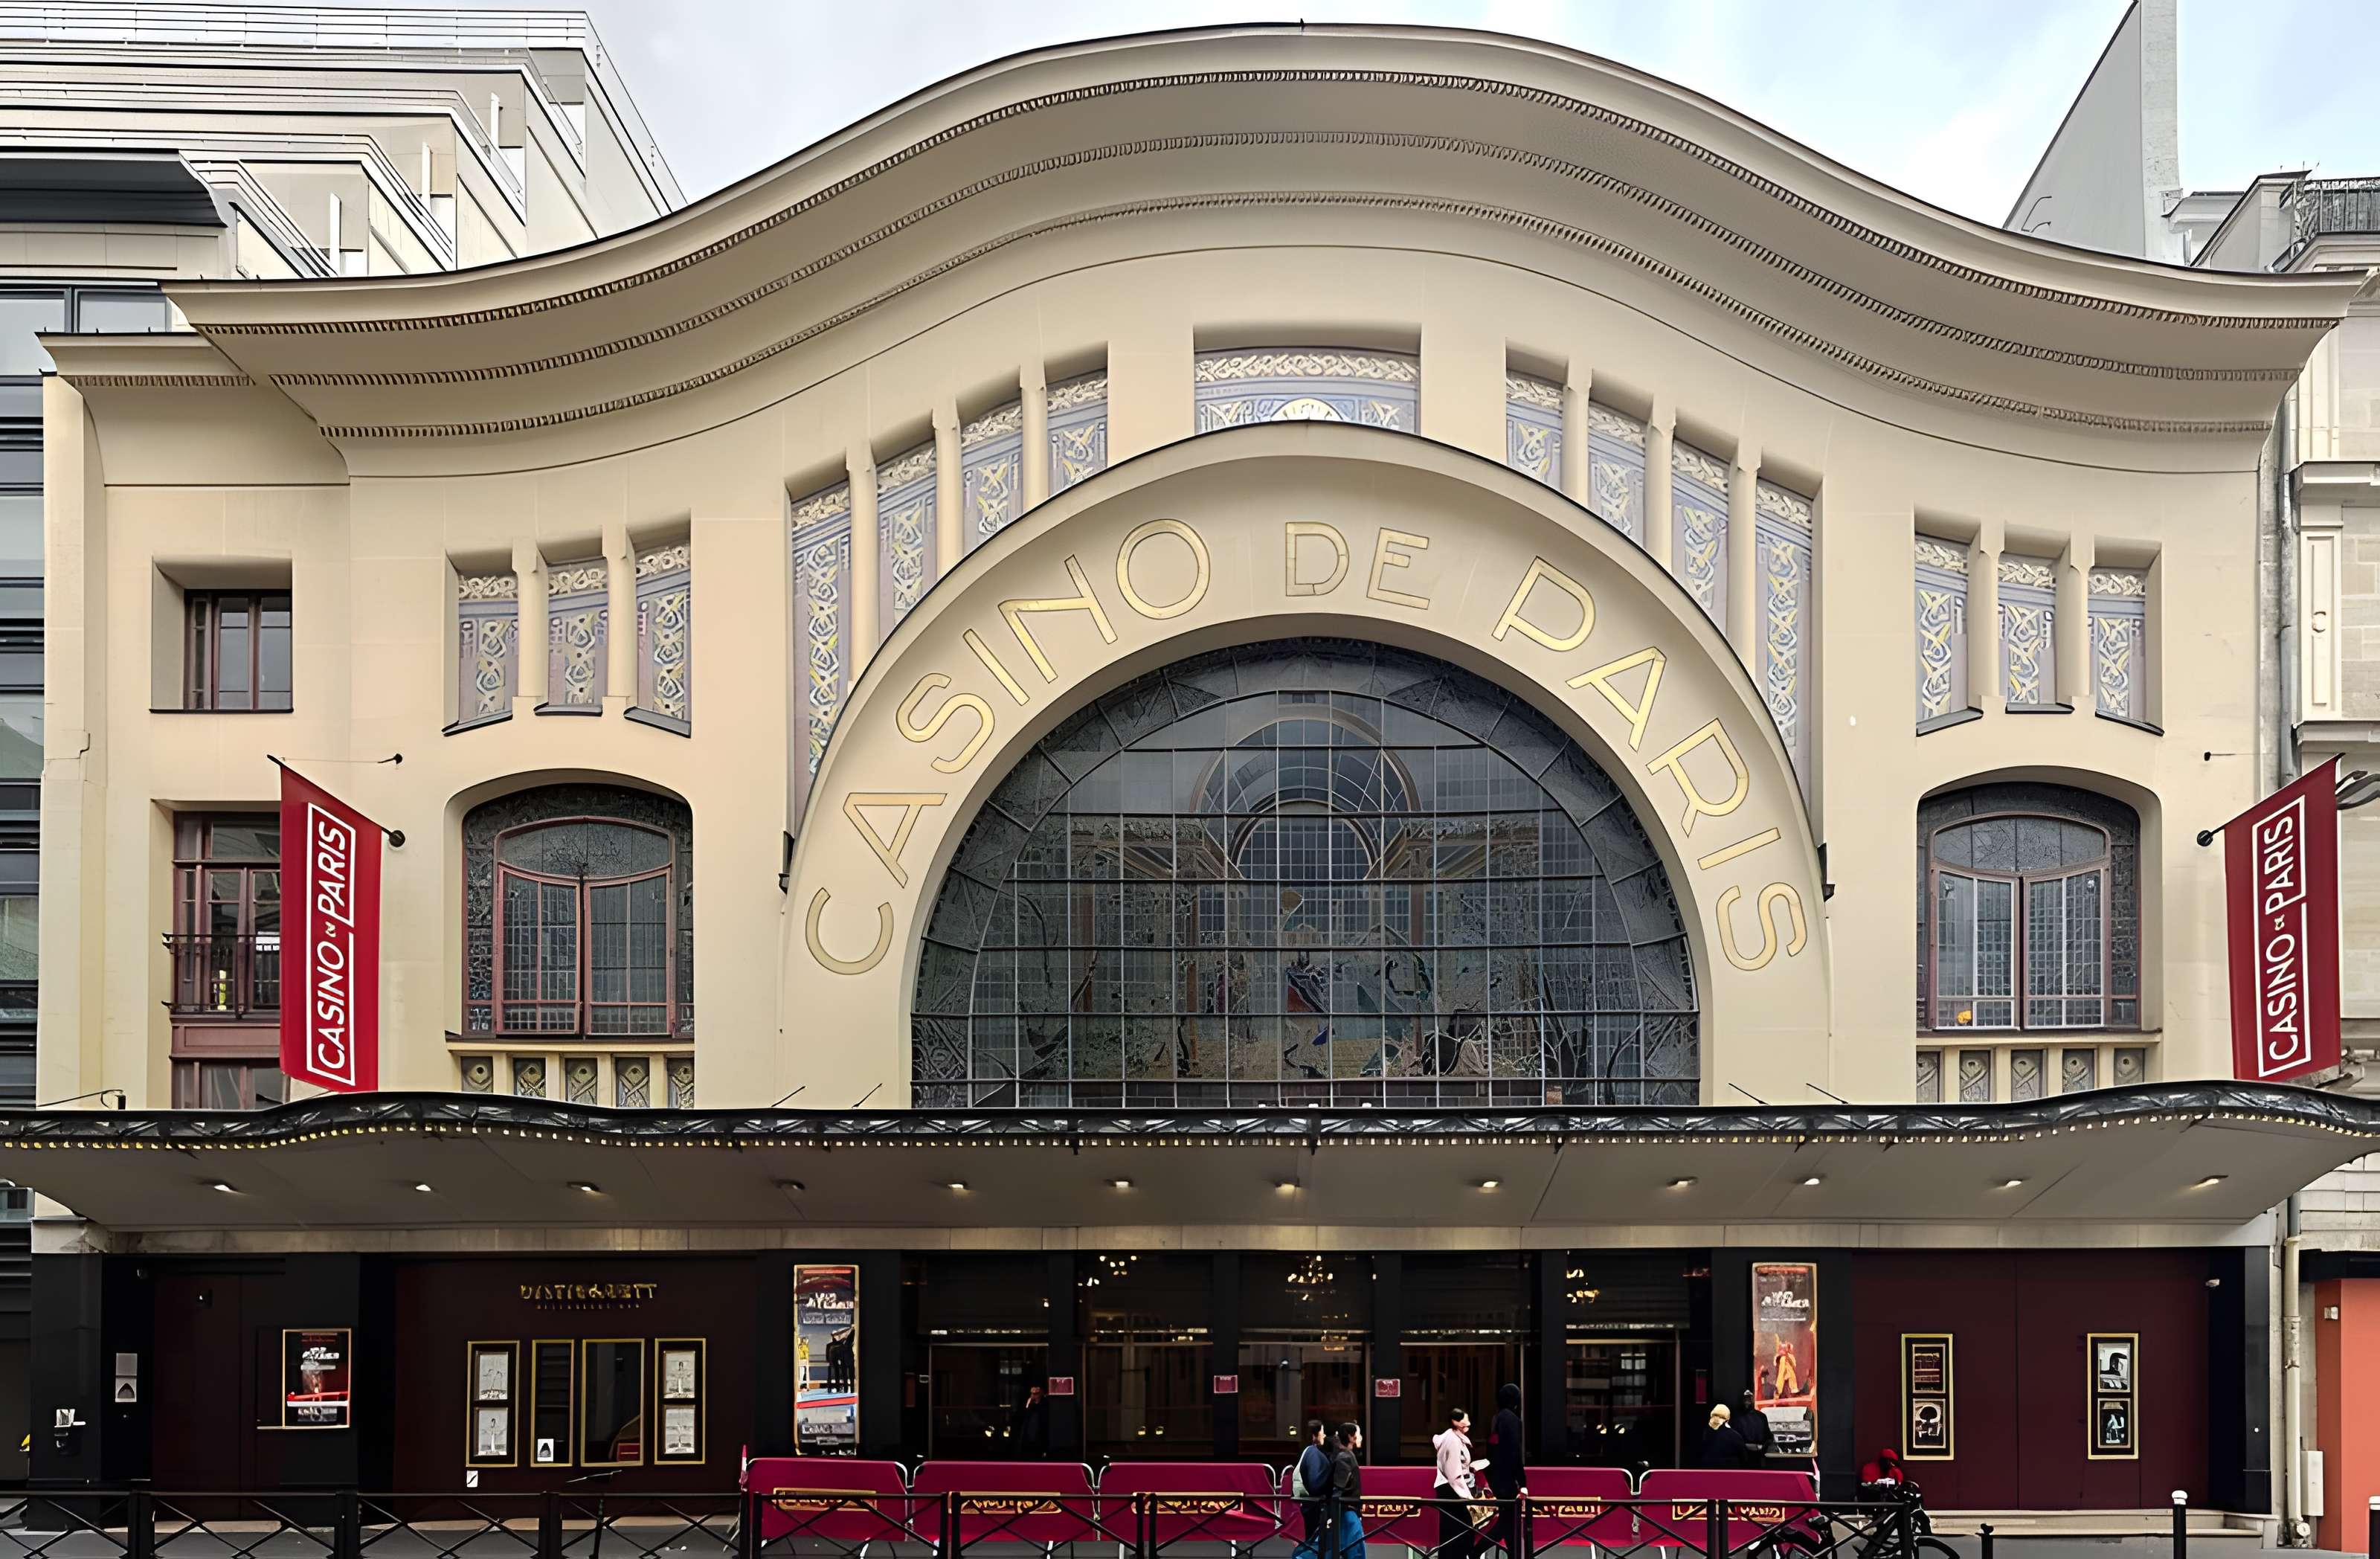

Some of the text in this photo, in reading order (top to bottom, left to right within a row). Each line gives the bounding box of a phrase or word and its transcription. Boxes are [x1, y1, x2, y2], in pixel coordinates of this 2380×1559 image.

[805, 518, 1807, 975] CASINO DE PARIS
[317, 820, 346, 1069] CASINO PARIS
[2264, 816, 2298, 1061] CASINO PARIS
